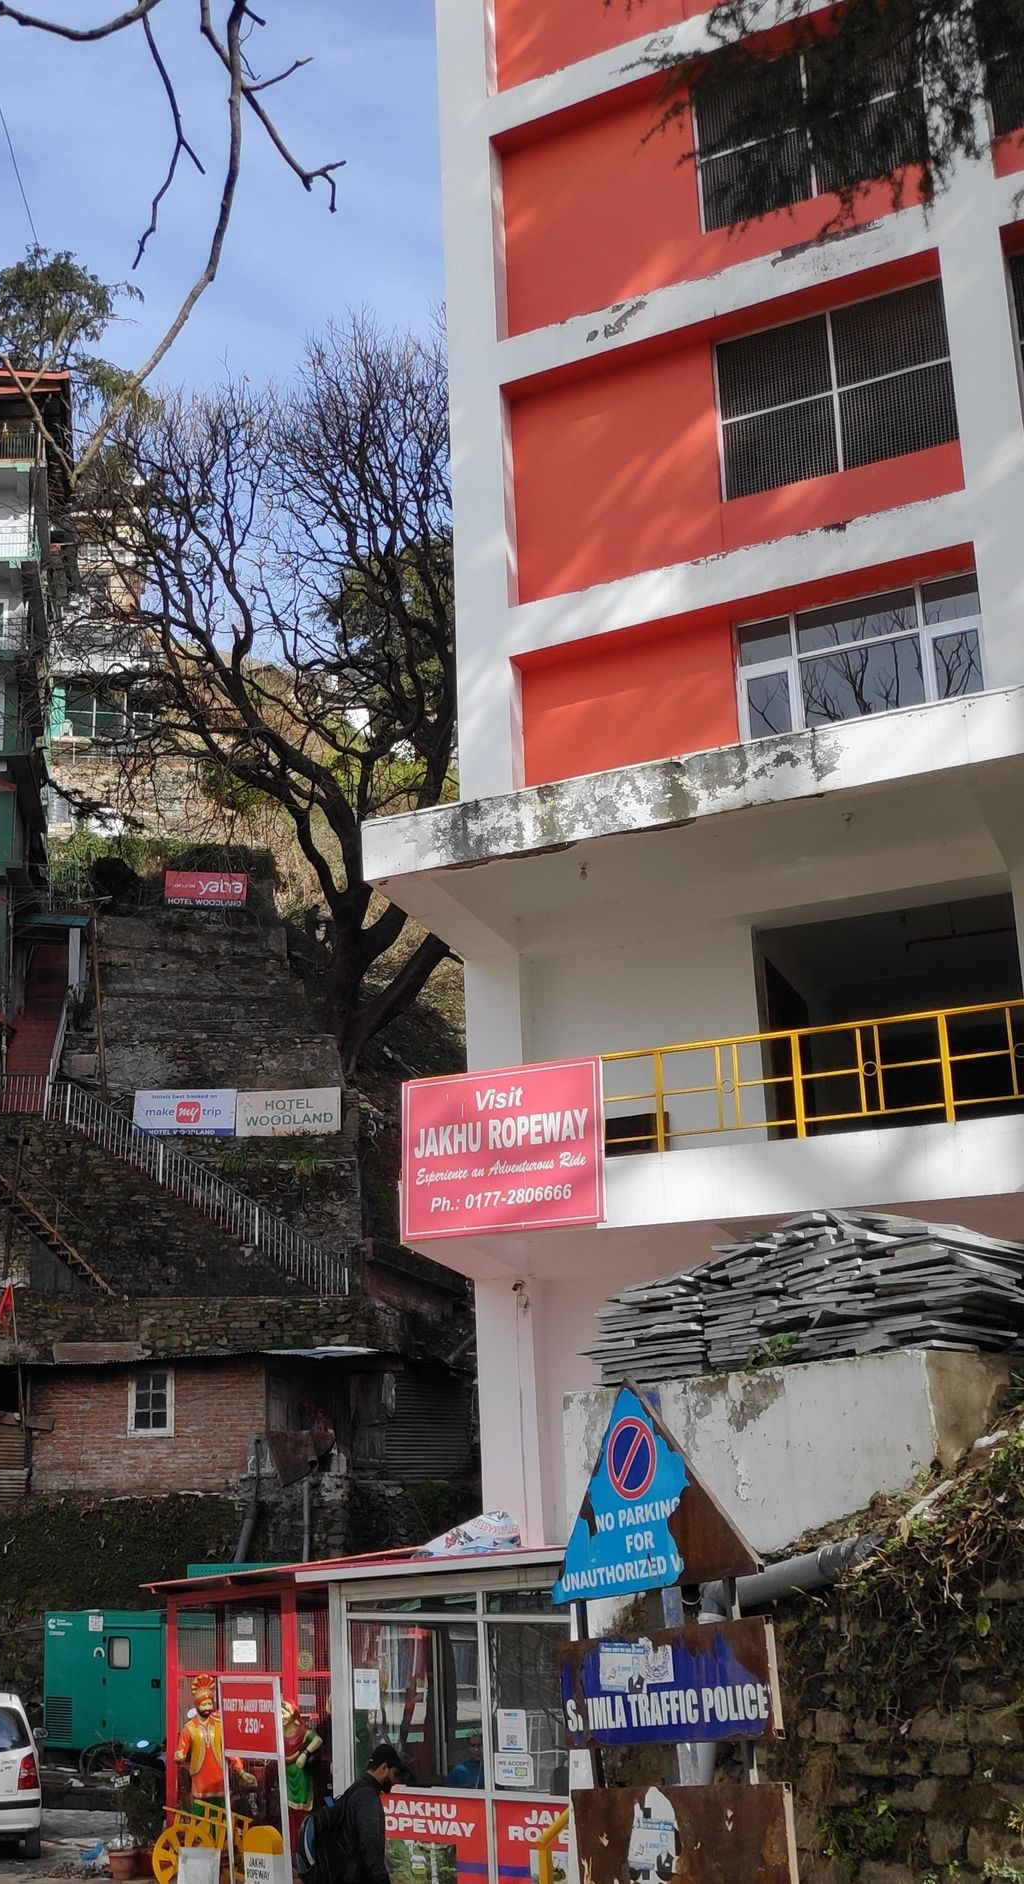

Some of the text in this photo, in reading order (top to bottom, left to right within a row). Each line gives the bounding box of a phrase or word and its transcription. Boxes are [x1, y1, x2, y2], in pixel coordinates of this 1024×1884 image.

[167, 897, 194, 906] HOTEL
[265, 1098, 314, 1111] HOTEL
[475, 1086, 524, 1112] Visit
[145, 1106, 222, 1122] make my trip
[245, 1112, 333, 1127] WOODLAND
[413, 1108, 589, 1159] JAKHU ROPEWAY
[415, 1151, 587, 1187] Experience an Adventurous Ride
[430, 1183, 573, 1213] Ph.: 0177-2806666
[595, 1512, 615, 1533] NO
[625, 1530, 655, 1554] FOR
[561, 1555, 667, 1593] UNAUTHORIZED
[566, 1683, 770, 1732] SIMLA TRAFFIC POLICE
[244, 1717, 265, 1734] 250/-
[383, 1798, 458, 1819] JAKHU
[384, 1816, 476, 1838] OPEWAY
